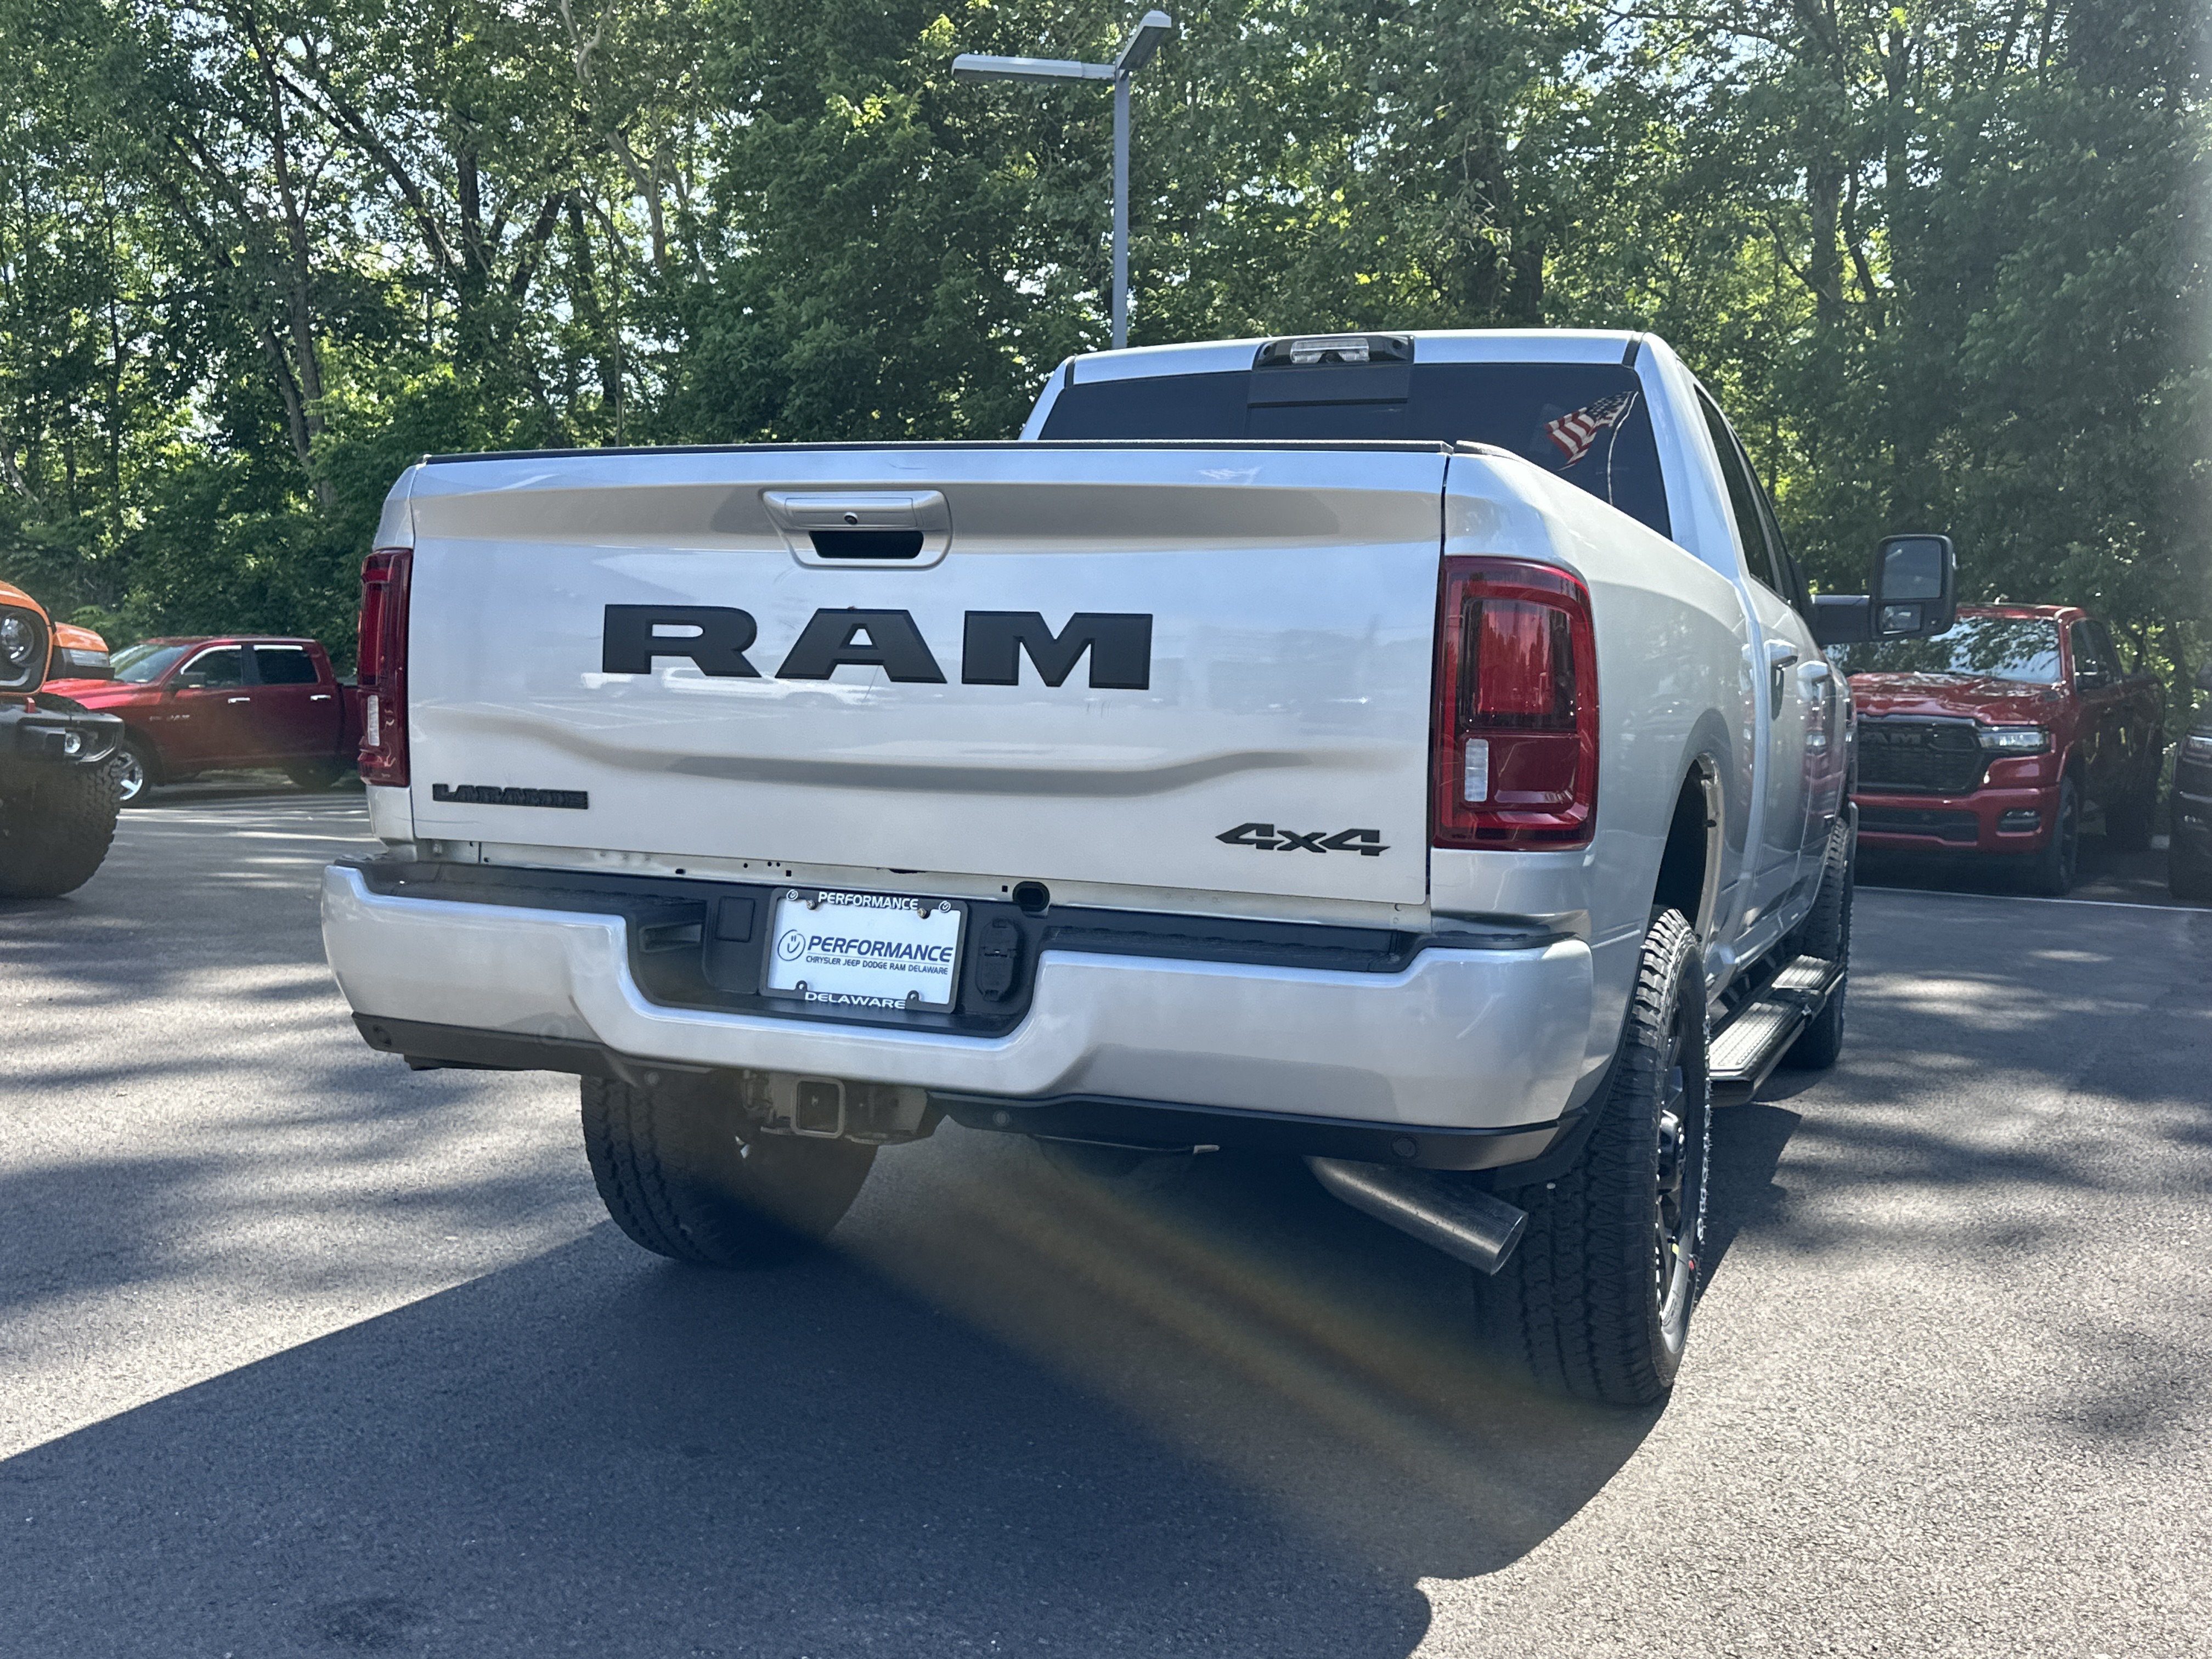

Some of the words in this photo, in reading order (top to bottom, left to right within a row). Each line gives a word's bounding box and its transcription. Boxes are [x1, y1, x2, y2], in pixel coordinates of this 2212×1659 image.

[602, 603, 1153, 690] RAM
[1859, 732, 1921, 744] AM
[432, 783, 589, 810] LARAMIE
[817, 891, 919, 910] PERFORMANCE
[807, 935, 953, 963] PERFORMANCE
[806, 956, 841, 965] CHRYSLER
[843, 958, 861, 967] JEEP
[862, 961, 888, 969] DODGE
[889, 963, 906, 971] RAM
[908, 964, 949, 975] DELAWARE
[805, 991, 906, 1009] DELAWARE
